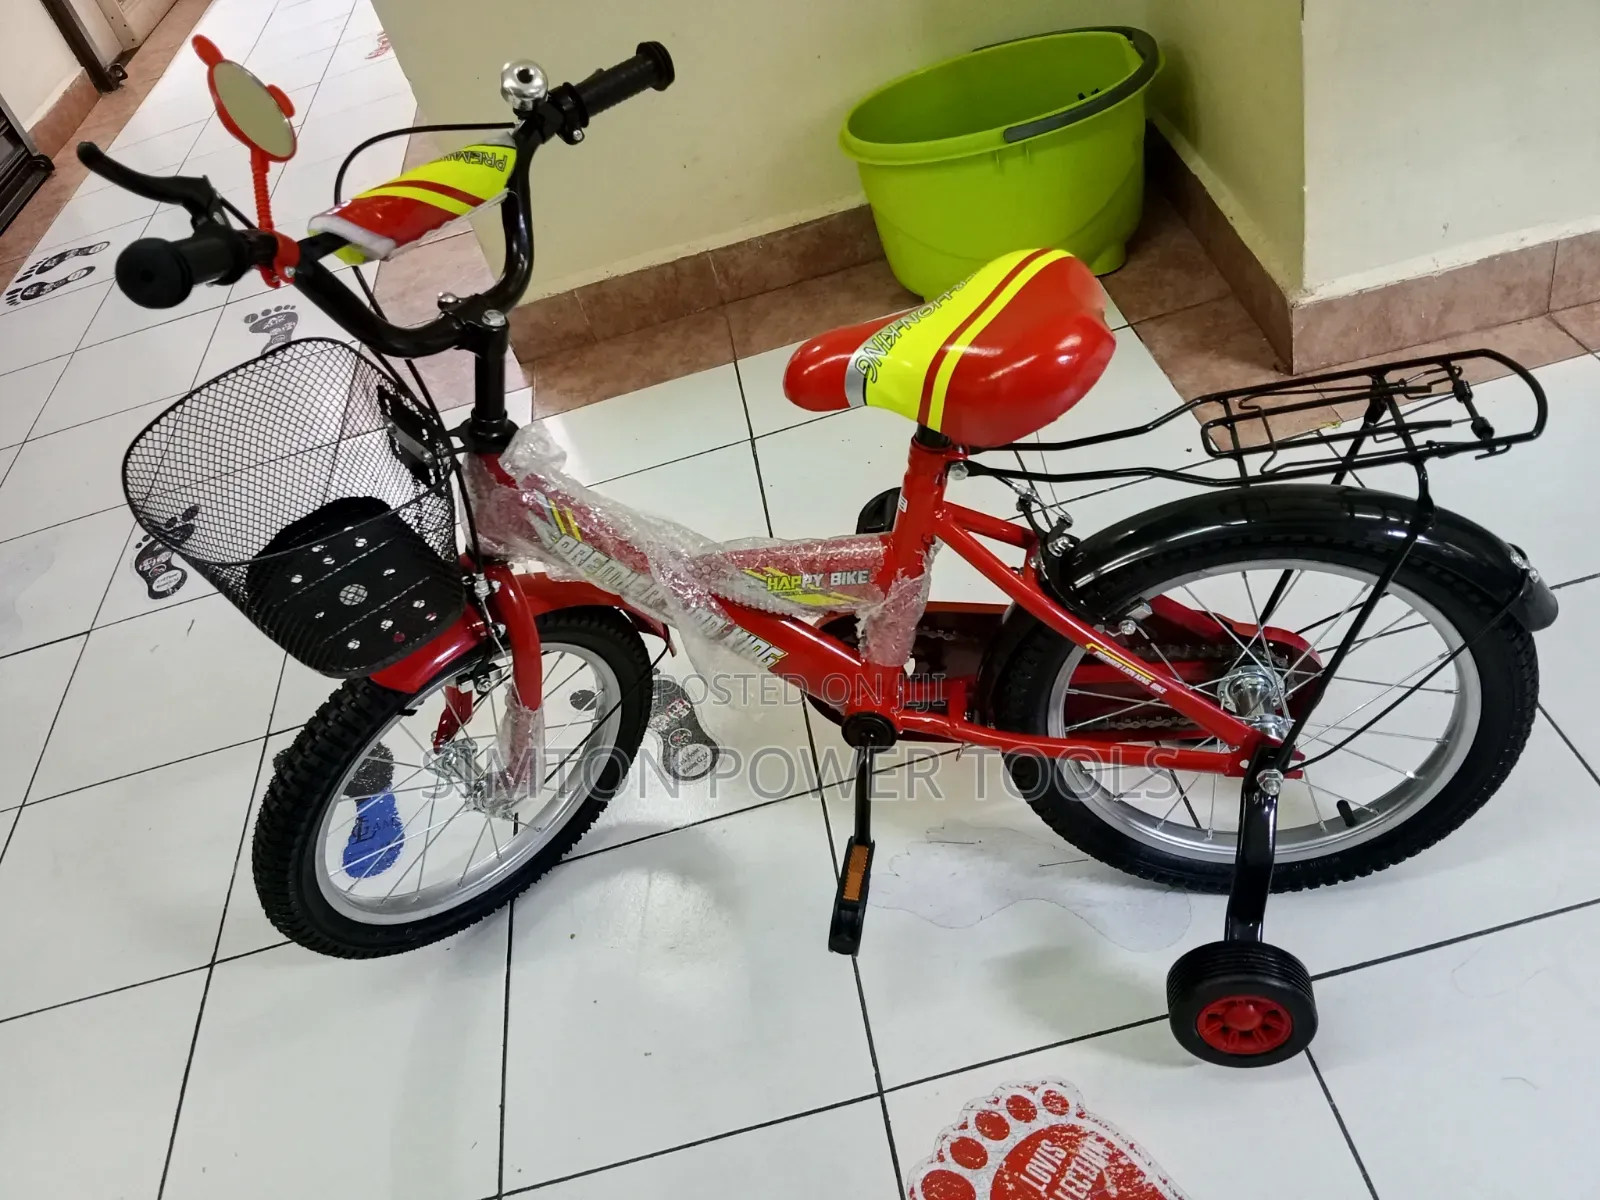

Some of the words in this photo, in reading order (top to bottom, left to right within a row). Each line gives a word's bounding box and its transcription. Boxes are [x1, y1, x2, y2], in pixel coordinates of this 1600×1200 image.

[899, 291, 952, 331] LION
[854, 325, 903, 384] KING
[766, 572, 826, 591] HAPPY
[830, 569, 871, 586] BIKE
